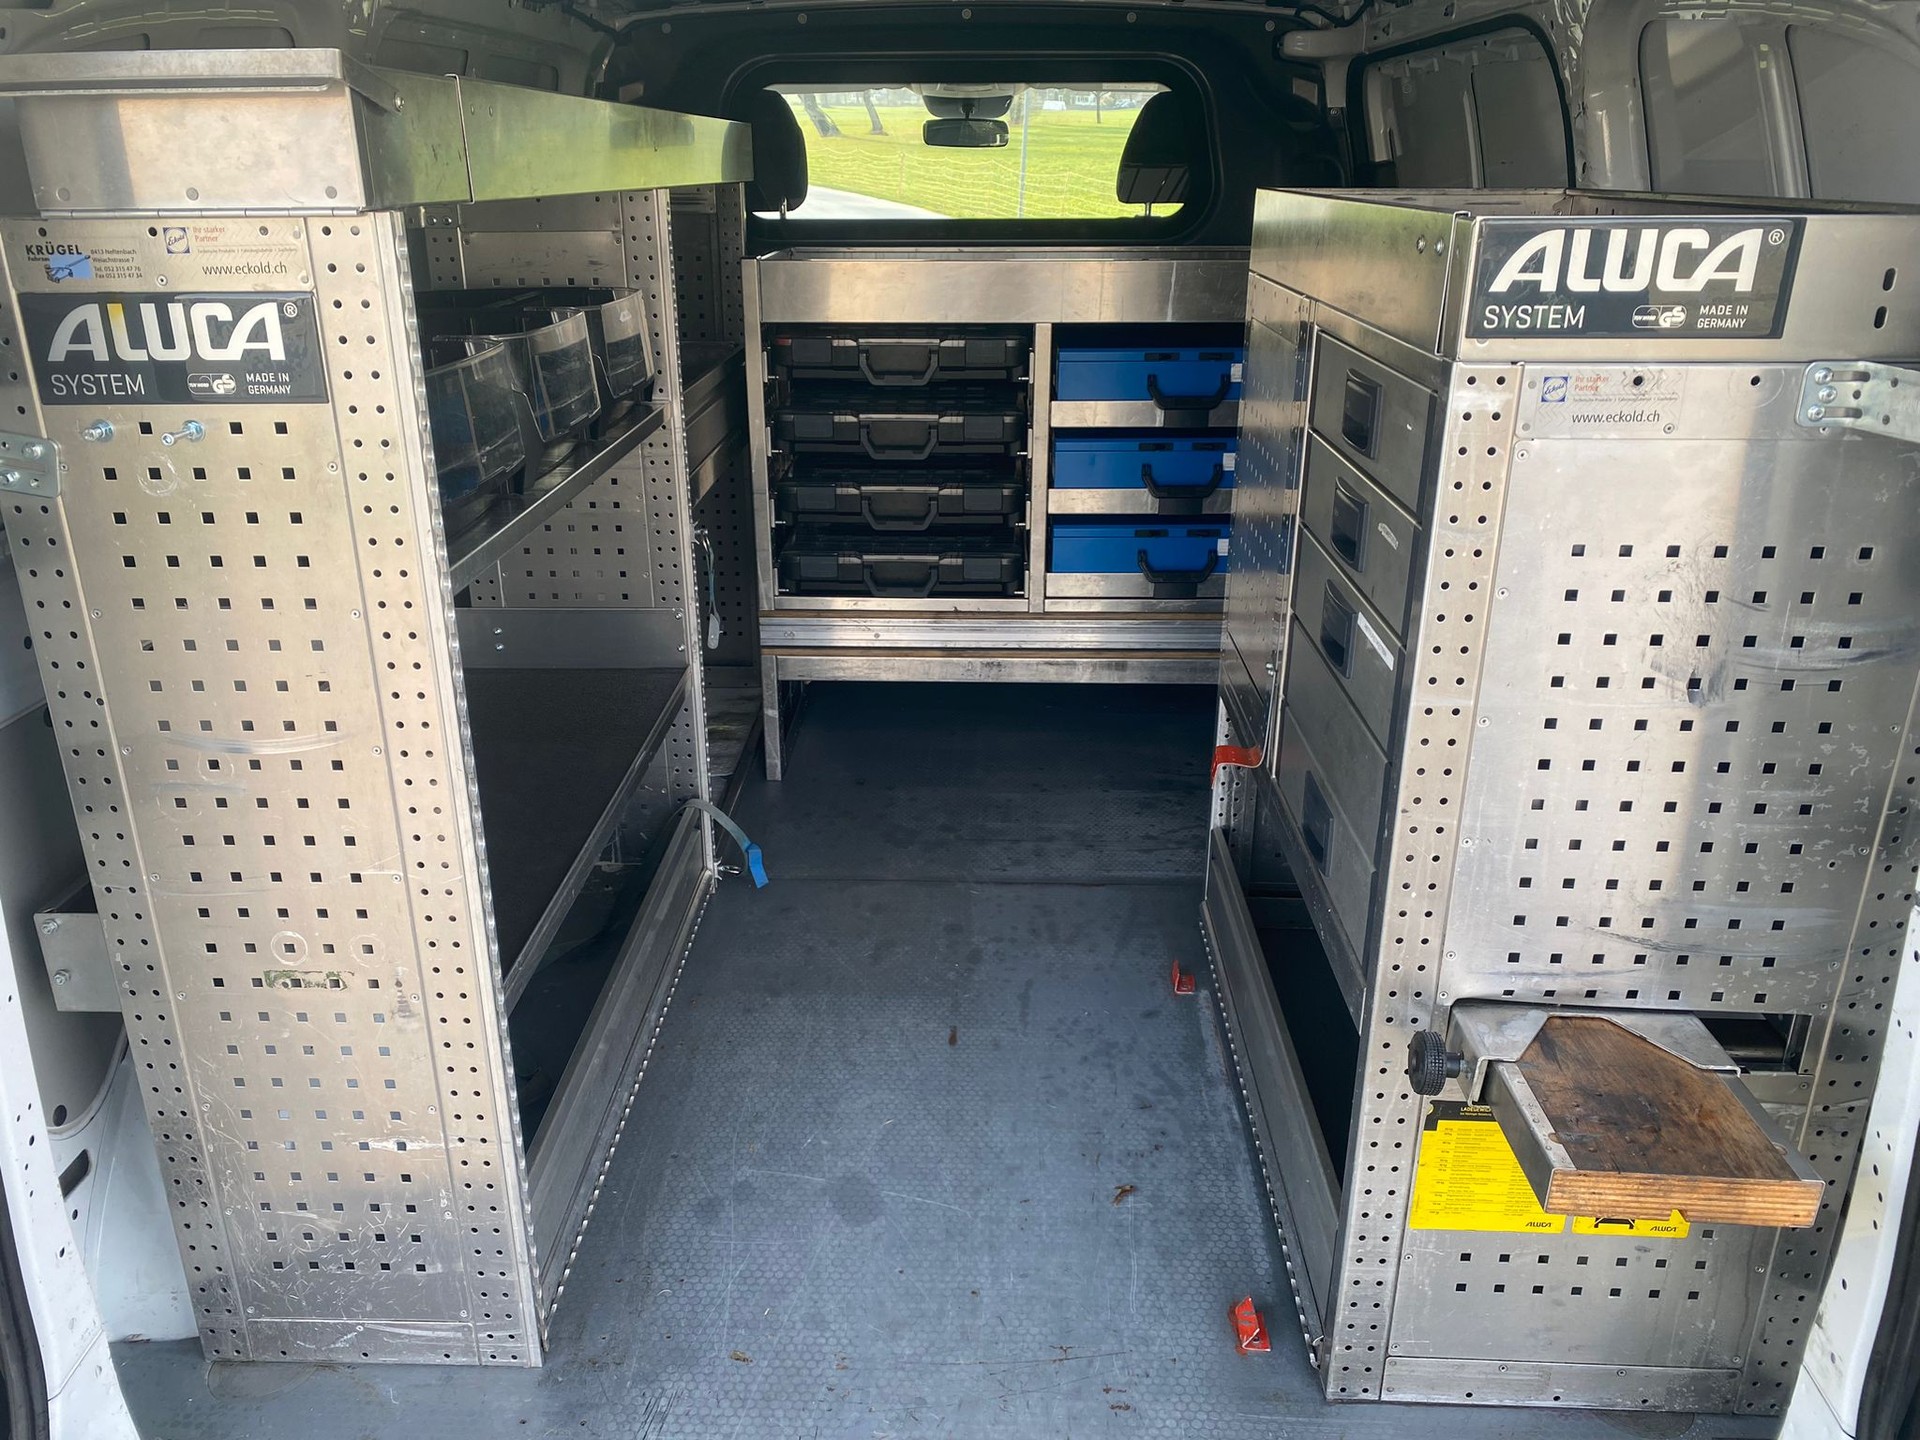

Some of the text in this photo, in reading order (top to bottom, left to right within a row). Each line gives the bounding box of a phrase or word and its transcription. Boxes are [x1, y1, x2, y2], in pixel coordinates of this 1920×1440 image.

[25, 241, 82, 255] KRÜGEL
[202, 261, 287, 275] www.eckold.ch
[1699, 305, 1748, 315] MADE IN
[1483, 305, 1585, 329] SYSTEM
[1697, 318, 1747, 328] GERMANY
[246, 373, 290, 382] MADE IN
[51, 374, 145, 396] SYSTEM
[248, 385, 291, 394] GERMANY
[1572, 410, 1660, 423] www.eckold.ch
[1525, 1220, 1552, 1228] ALUCA
[1650, 1225, 1677, 1233] ALUCA
